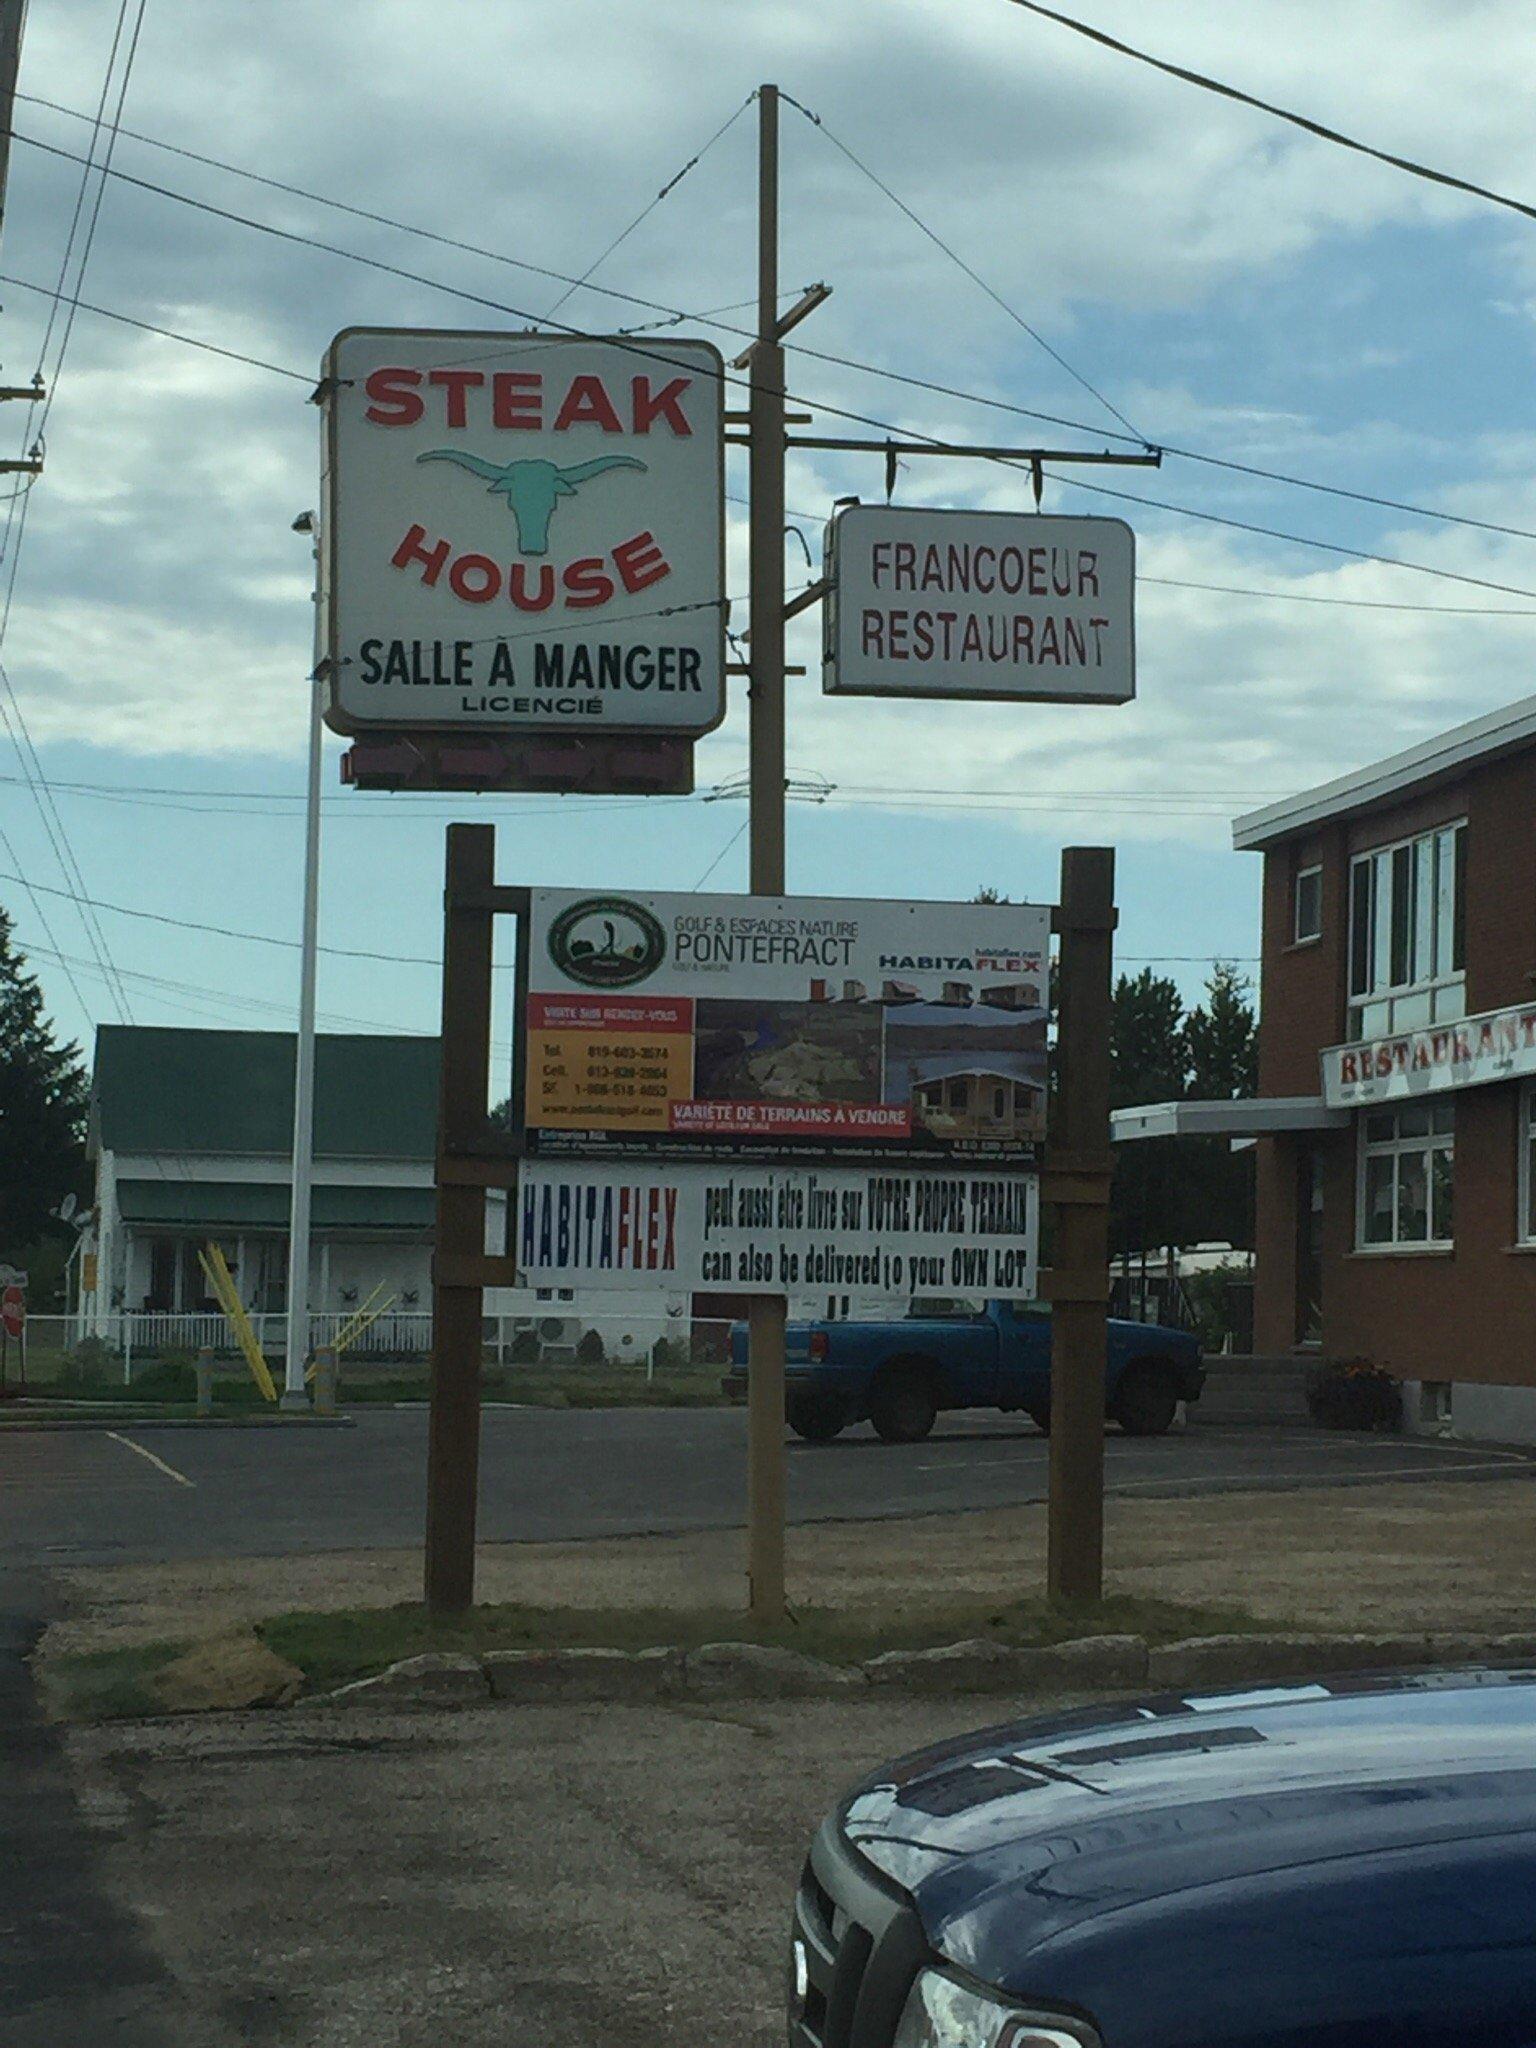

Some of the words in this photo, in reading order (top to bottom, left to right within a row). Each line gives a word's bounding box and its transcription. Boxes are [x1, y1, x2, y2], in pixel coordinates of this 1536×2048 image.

[364, 367, 692, 436] STEAK
[391, 524, 671, 612] HOUSE
[872, 542, 1099, 597] FRANCOEUR
[862, 608, 1110, 666] RESTAURANT
[360, 638, 473, 687] SALLE
[534, 643, 702, 692] MANGER
[461, 695, 604, 714] LICENCIÉ
[674, 915, 712, 932] GOLF
[714, 917, 726, 933] &
[730, 917, 796, 935] ESPACES
[799, 920, 858, 938] NATURE
[675, 933, 856, 966] PONTEFRACT
[878, 954, 1040, 972] HABITAFLEX
[737, 1105, 757, 1120] DE
[760, 1106, 831, 1124] TERRAINS
[849, 1109, 906, 1126] VENDRE
[522, 1184, 678, 1271] HABITAFLEX
[739, 1174, 773, 1229] aussi
[842, 1190, 863, 1231] sur
[702, 1250, 731, 1281] can
[738, 1243, 773, 1282] also
[779, 1243, 799, 1283] be
[805, 1243, 881, 1285] delivered
[883, 1254, 903, 1290] to
[909, 1255, 945, 1295] your
[951, 1246, 989, 1288] OWN
[994, 1248, 1027, 1289] LOT
